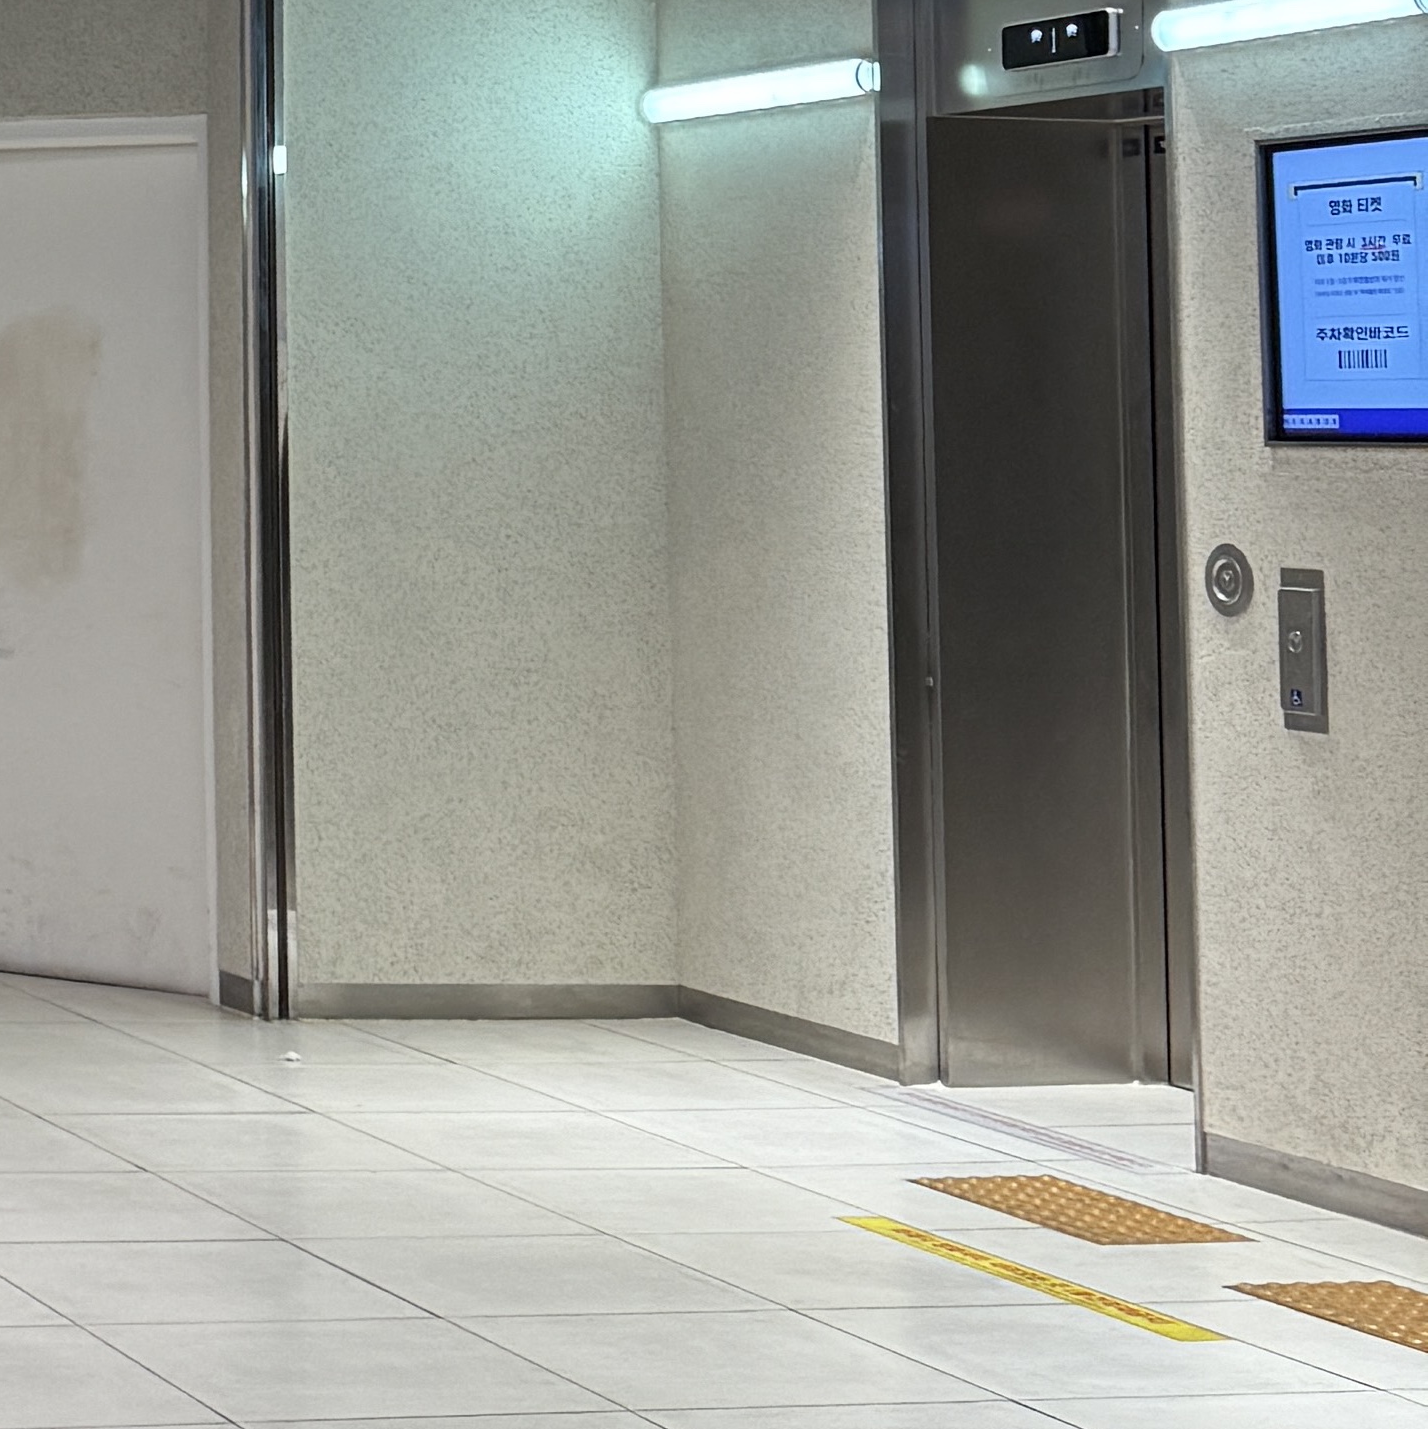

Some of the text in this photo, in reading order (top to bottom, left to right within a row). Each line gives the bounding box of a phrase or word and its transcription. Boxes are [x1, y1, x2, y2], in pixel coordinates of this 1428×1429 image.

[1329, 196, 1382, 216] 영화 티켓
[1315, 325, 1410, 342] 주차확인바코드
